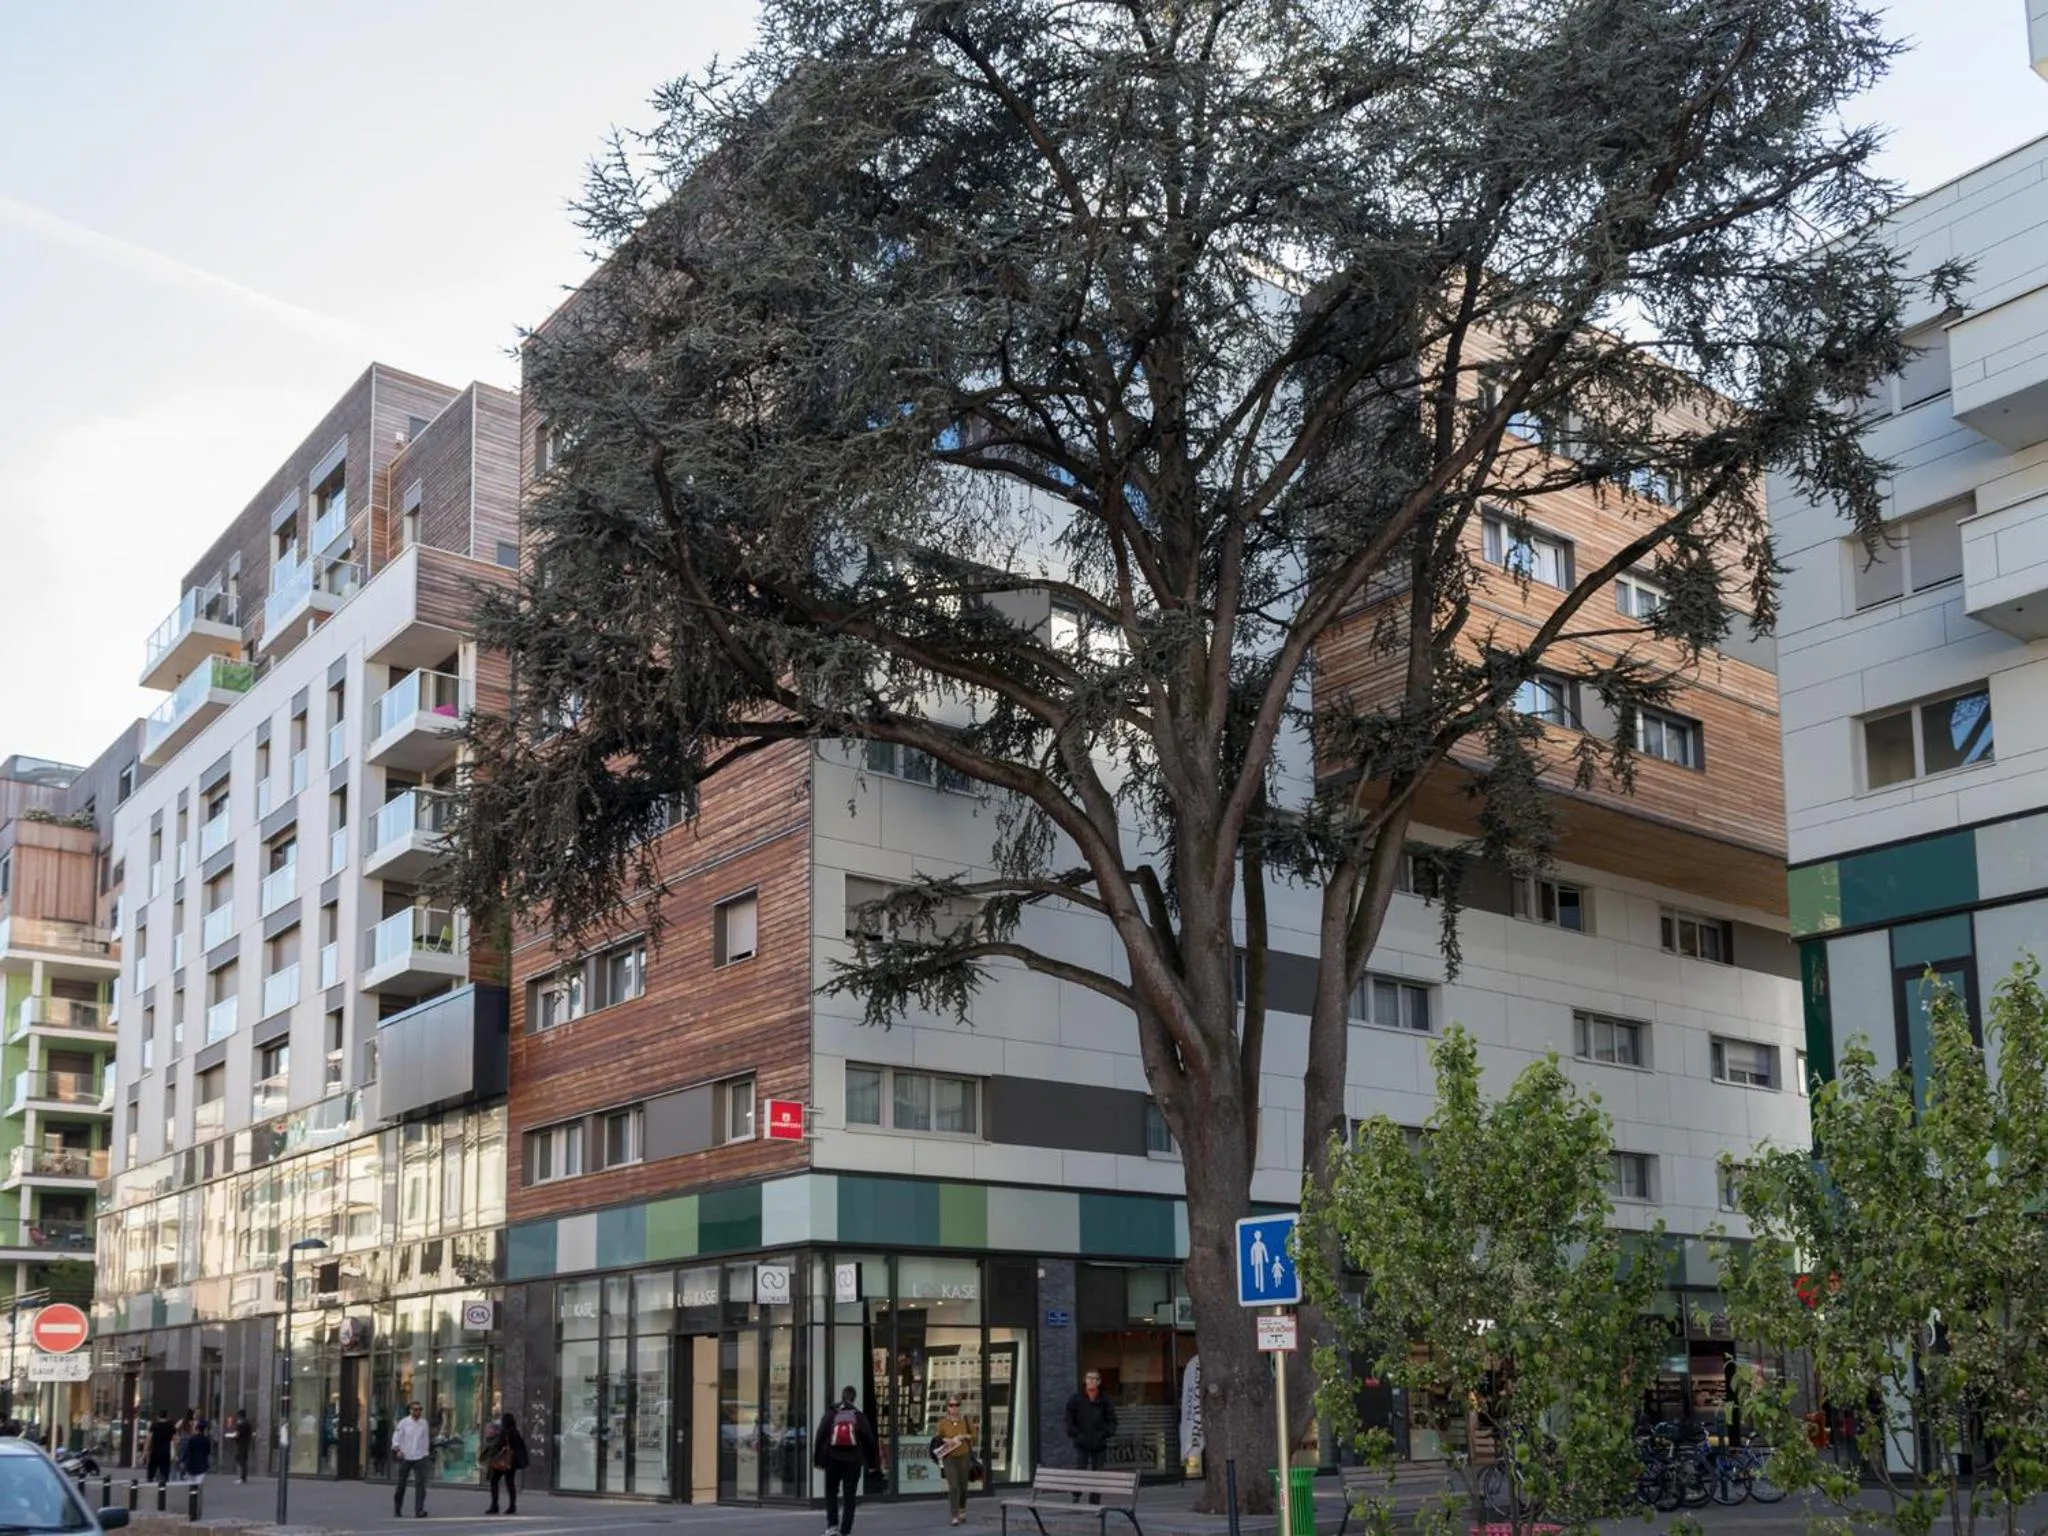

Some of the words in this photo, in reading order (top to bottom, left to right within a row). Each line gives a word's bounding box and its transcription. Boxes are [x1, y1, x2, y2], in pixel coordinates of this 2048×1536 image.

[912, 1283, 977, 1299] LKASE
[38, 1354, 80, 1363] INTERDIT
[31, 1366, 55, 1377] SAUF
